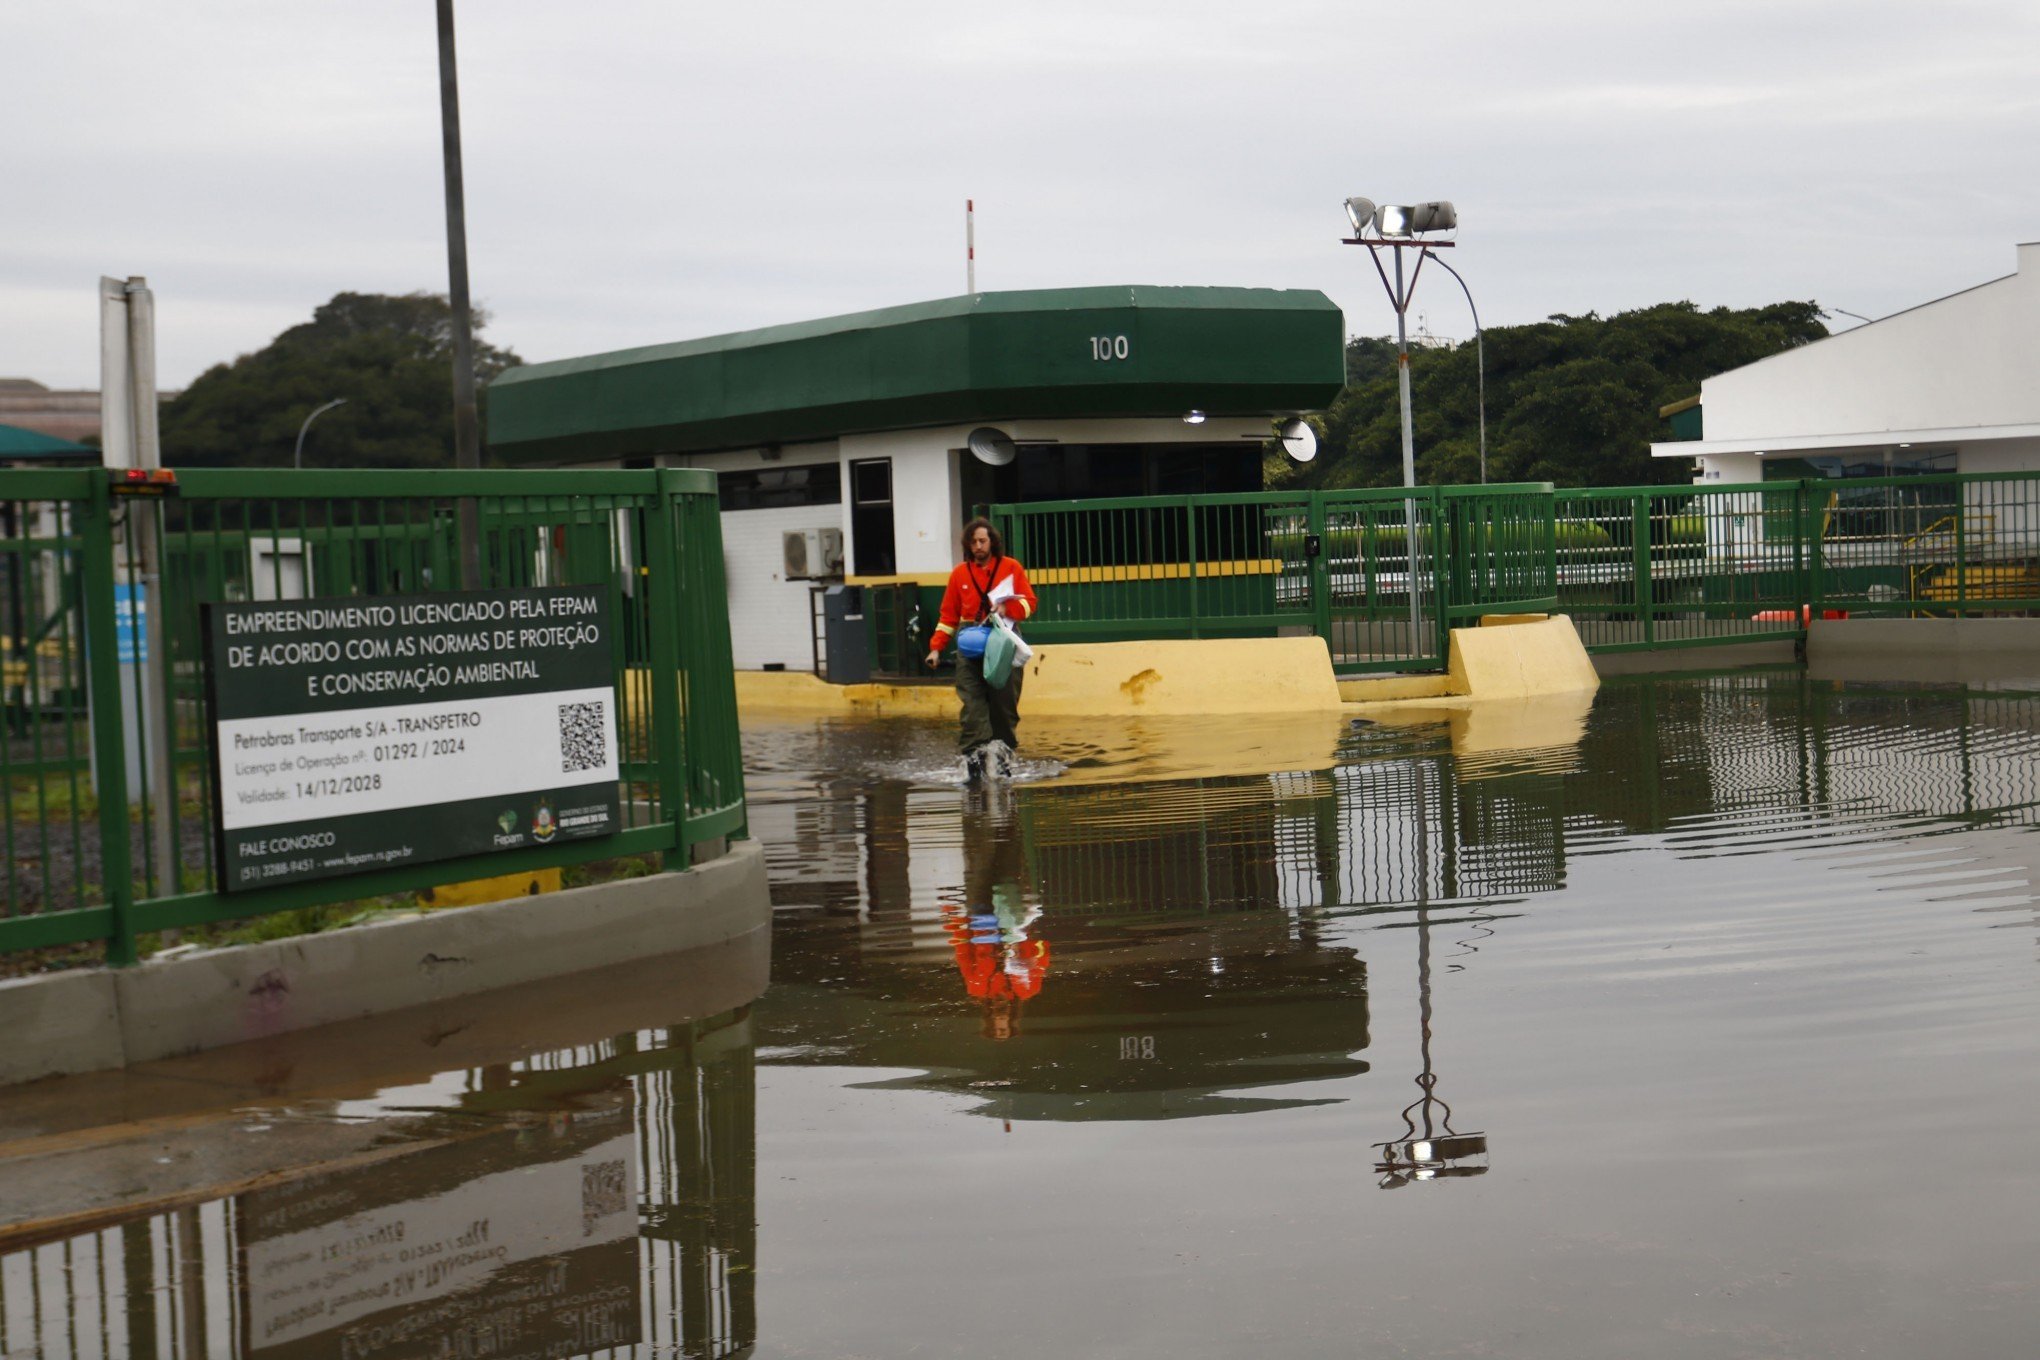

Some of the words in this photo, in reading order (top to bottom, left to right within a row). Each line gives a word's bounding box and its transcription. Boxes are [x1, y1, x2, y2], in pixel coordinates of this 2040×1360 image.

[1089, 335, 1129, 361] 100
[225, 605, 395, 635] EMPREENDIMENTO
[400, 600, 505, 625] LICENCIADO
[510, 599, 547, 619] PELA
[550, 596, 598, 617] FEPAM
[228, 646, 254, 668] DE
[258, 640, 341, 666] ACORDO
[345, 638, 391, 661] COM
[394, 636, 416, 657] AS
[420, 632, 490, 655] NORMAS
[494, 630, 516, 650] DE
[519, 621, 600, 650] PROTEÇÃO
[307, 676, 318, 697] E
[322, 663, 450, 696] CONSERVAÇÃO
[454, 660, 540, 685] AMBIENTAL
[235, 730, 295, 749] Petrobras
[298, 725, 362, 744] Transporte
[365, 721, 388, 738] S/A
[397, 711, 481, 734] TRANSPETRO
[235, 762, 276, 776] Licença
[280, 759, 293, 771] de
[296, 753, 349, 771] Operação
[374, 743, 418, 762] 01292
[422, 741, 429, 758] /
[432, 737, 465, 756] 2024
[296, 774, 382, 799] 14/12/2028
[239, 840, 268, 857] FALE
[269, 831, 336, 854] CONOSCO
[493, 833, 524, 845] Fepam
